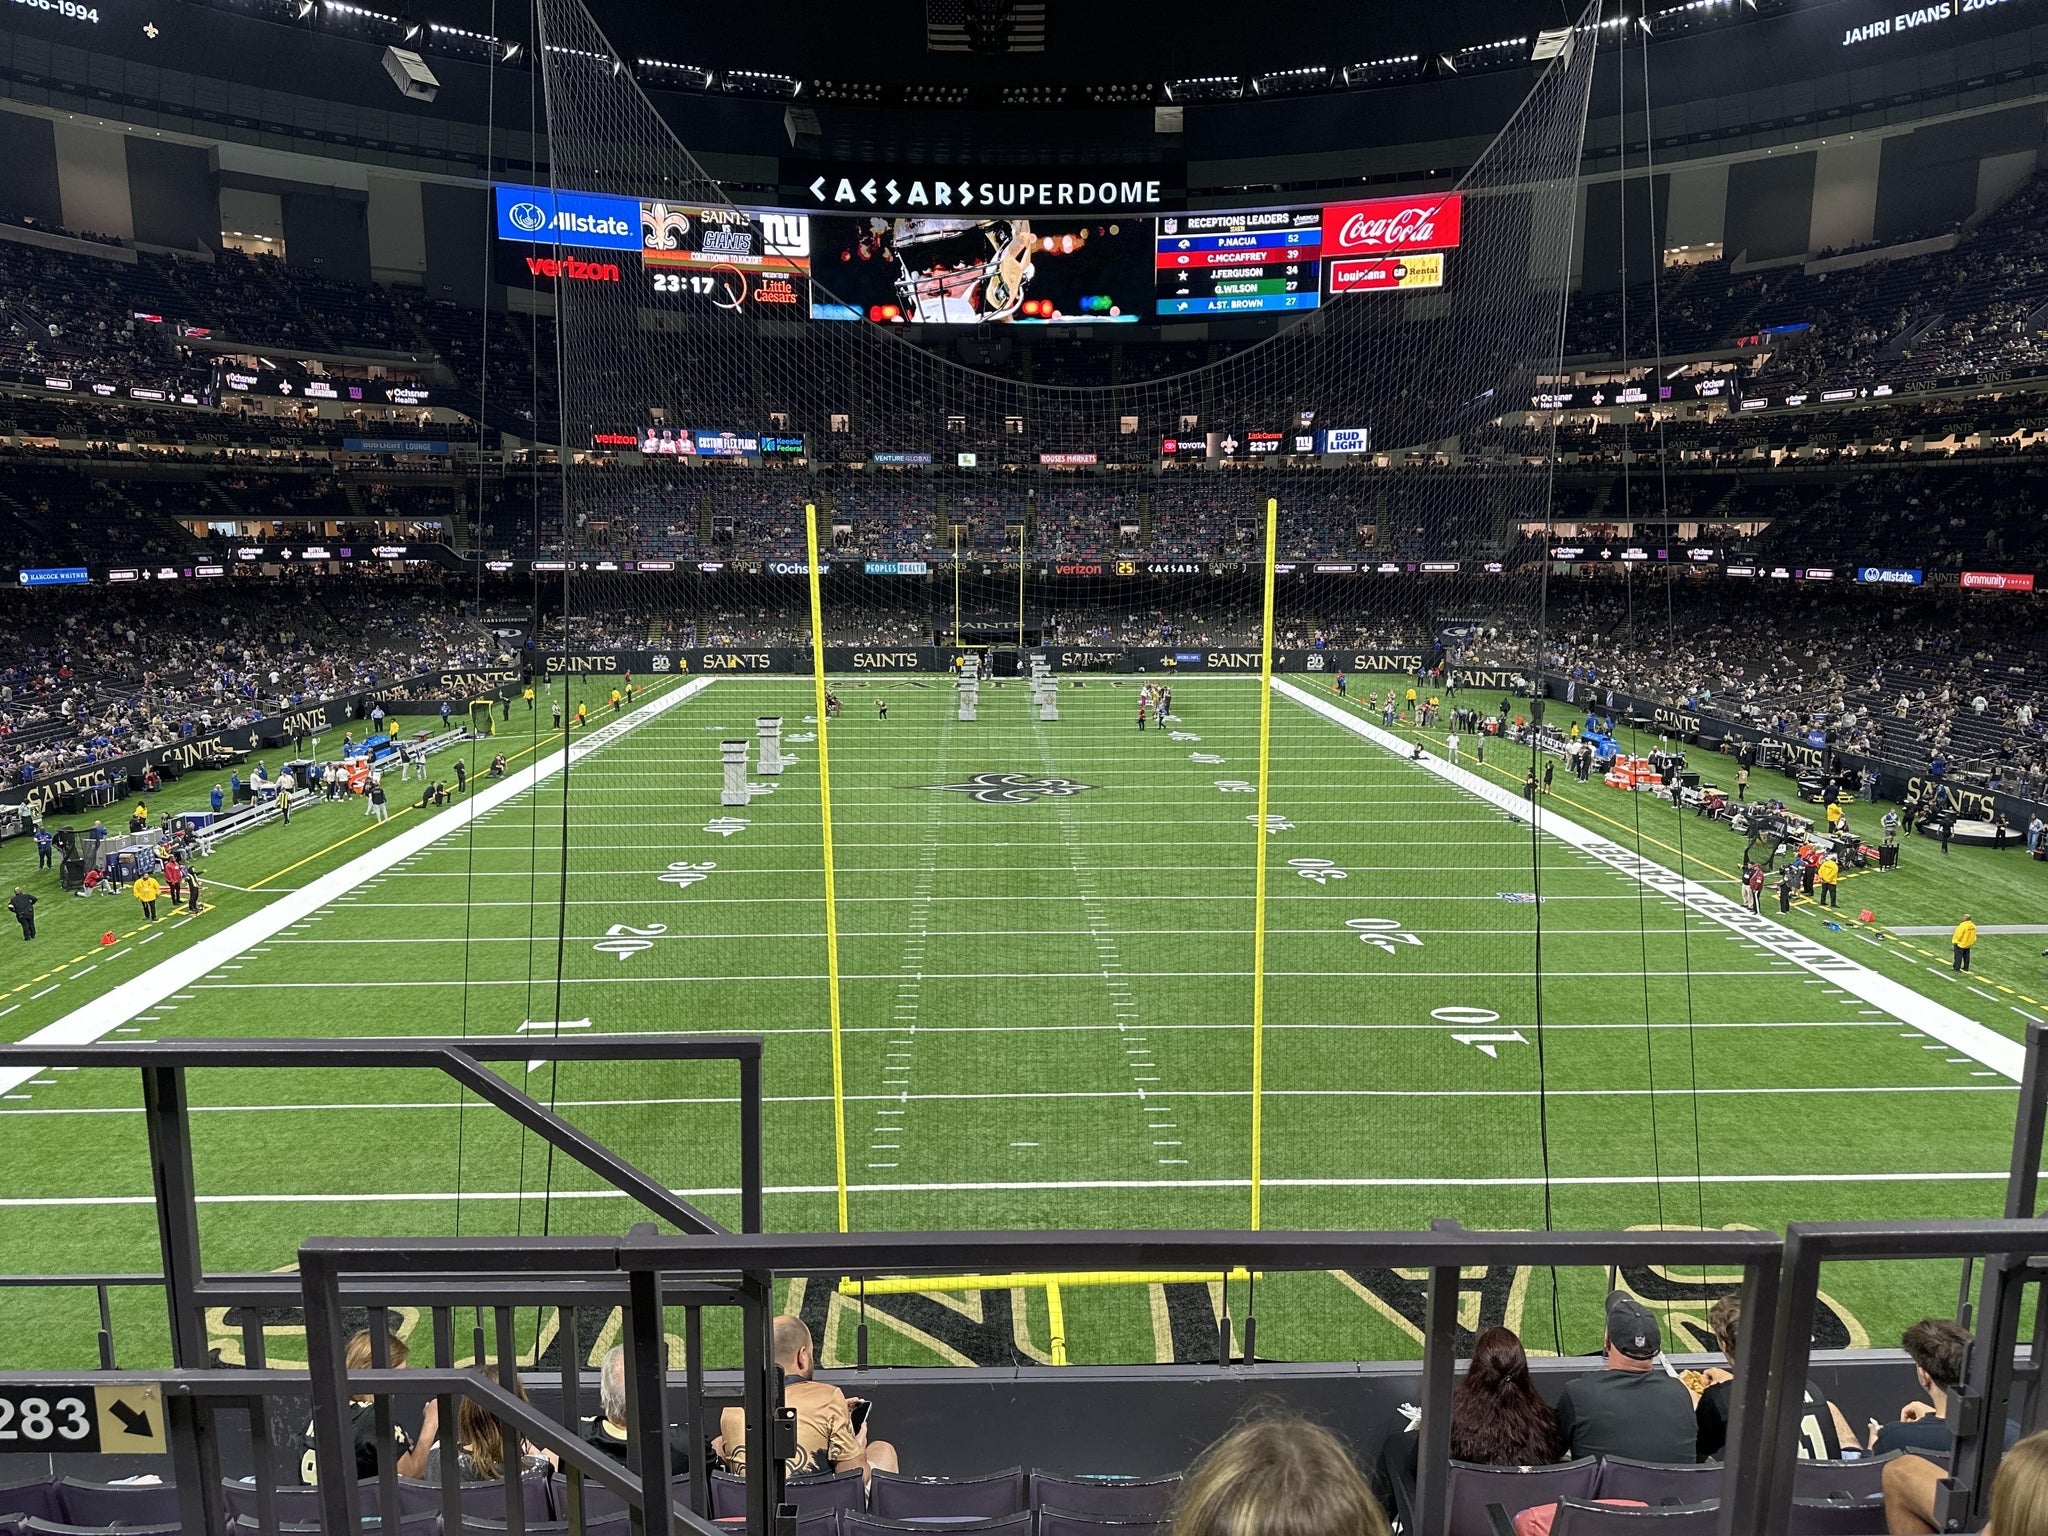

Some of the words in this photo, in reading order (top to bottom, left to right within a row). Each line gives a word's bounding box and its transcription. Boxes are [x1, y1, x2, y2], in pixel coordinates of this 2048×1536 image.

[1842, 19, 1889, 46] JAHRI
[1895, 2, 1950, 31] EVANS
[809, 176, 974, 207] CAESARS
[979, 181, 1160, 205] SUPERDOME
[701, 210, 750, 226] SAINTS
[1188, 216, 1246, 229] RECEPTIONS
[1246, 213, 1290, 226] LEADERS
[547, 211, 629, 238] Allstate
[1339, 206, 1441, 247] Coca-Cola
[703, 230, 751, 250] GIANTS
[1218, 237, 1257, 247] P.NACUA
[1288, 234, 1299, 242] 52
[691, 252, 730, 262] COUNTDOWN
[730, 254, 738, 263] TO
[739, 255, 763, 264] KICKOFF
[1207, 252, 1267, 263] C.MCCAFFREY
[1287, 250, 1298, 258] 39
[526, 256, 619, 282] verizon
[1210, 267, 1263, 279] J.FERGUSON
[1286, 265, 1298, 275] 34
[1409, 266, 1439, 275] Rental
[1338, 269, 1387, 282] Louisiana
[653, 274, 715, 295] 23:17
[762, 279, 792, 293] Little
[1214, 284, 1258, 294] G.WILSON
[1286, 281, 1297, 290] 27
[754, 289, 797, 304] Caesars
[1286, 297, 1296, 305] 27
[1208, 300, 1229, 310] A.ST.
[1231, 299, 1263, 309] BROWN
[230, 373, 257, 384] Ochsner
[1977, 370, 2011, 384] SAINTS
[1904, 380, 1938, 391] SAINTS
[394, 388, 429, 399] Ochsner
[394, 396, 418, 405] Health
[56, 423, 88, 434] SAINTS
[124, 428, 157, 440] SAINTS
[195, 432, 229, 443] SAINTS
[269, 436, 303, 446] SAINTS
[594, 433, 637, 445] verizon
[777, 437, 803, 445] Keesler
[1335, 431, 1359, 441] BUD
[405, 442, 432, 450] LOUNGE
[724, 438, 737, 449] FLEX
[777, 444, 803, 452] Federal
[1178, 442, 1206, 450] TOYOTA
[1250, 440, 1278, 452] 23:17
[1330, 440, 1364, 451] LIGHT
[1066, 454, 1097, 463] MARKETS
[379, 546, 407, 554] Ochsner
[731, 561, 762, 569] SAINTS
[776, 563, 830, 575] Ochser
[866, 563, 896, 573] PEOPLES
[898, 563, 926, 574] HEALTH
[1055, 564, 1102, 575] verizon
[1118, 563, 1133, 573] 25
[1147, 564, 1200, 573] CAESARS
[1208, 562, 1238, 570] SAINTS
[1879, 571, 1915, 583] Allstate
[1927, 571, 1960, 583] SAINTS
[1964, 573, 2006, 587] Community
[950, 621, 1026, 630] SAINTS
[546, 655, 617, 672] SAINTS
[853, 652, 918, 668] SAINTS
[1207, 653, 1263, 668] SAINT
[1354, 655, 1422, 671] SAINTS
[440, 671, 517, 690] SAINTS
[282, 708, 326, 736] SAINTS
[1654, 708, 1701, 733] SAINTS
[702, 816, 752, 833] 40
[1287, 858, 1348, 880] 30
[1581, 842, 1686, 885] CANCER
[656, 861, 717, 883] 30
[1345, 917, 1424, 947] 20
[1670, 889, 1860, 971] INTERCEPT
[592, 923, 668, 953] 20
[1430, 1006, 1530, 1046] 10
